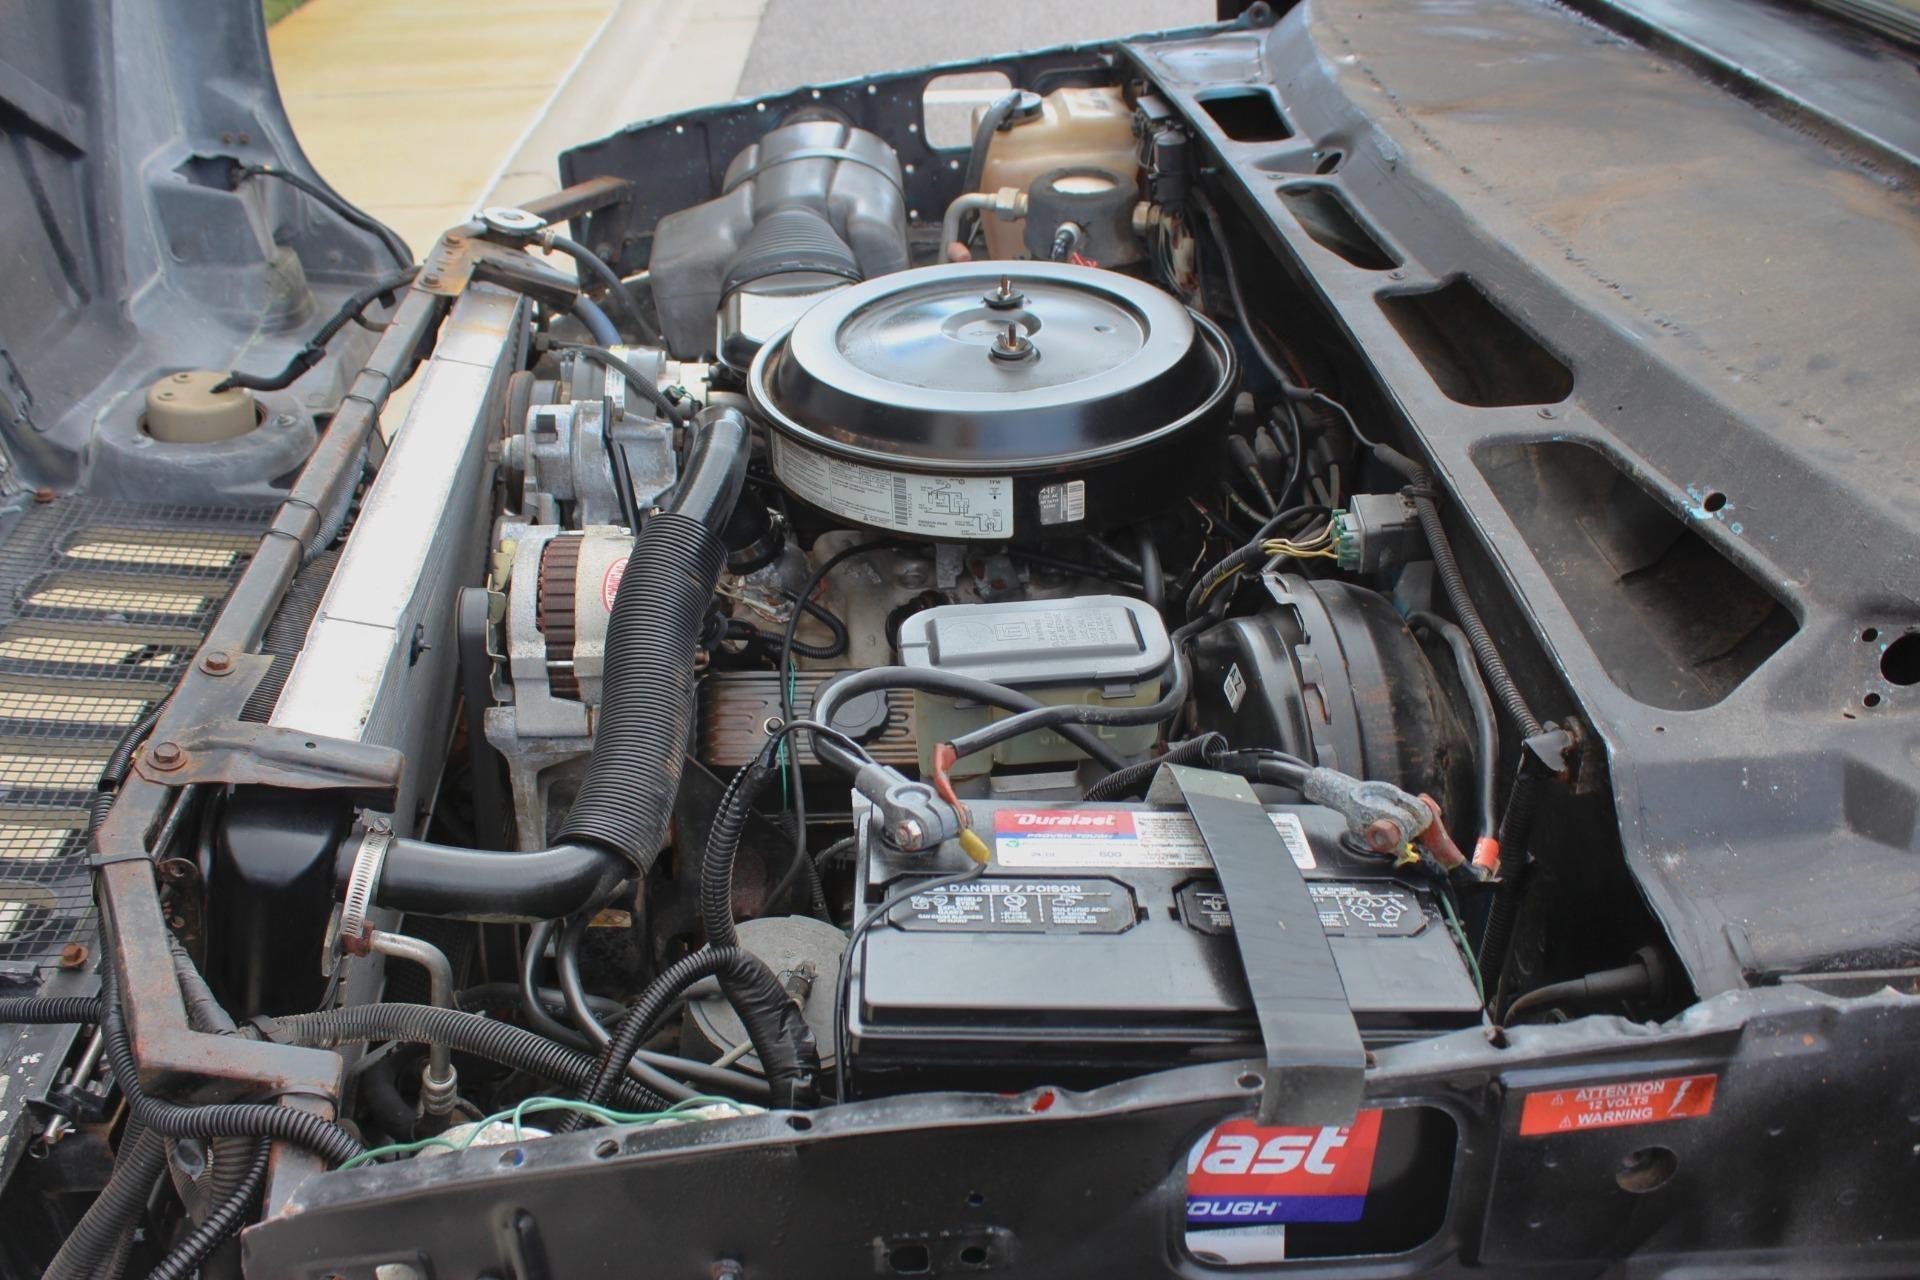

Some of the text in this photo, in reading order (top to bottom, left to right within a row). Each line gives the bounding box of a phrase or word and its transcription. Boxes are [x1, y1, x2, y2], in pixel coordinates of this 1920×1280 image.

[1014, 813, 1115, 826] Duralast
[949, 884, 1010, 893] DANGER
[1026, 884, 1082, 893] POISON
[1575, 1081, 1665, 1102] ATTENTION
[1588, 1095, 1649, 1110] 12 VOLTS
[1578, 1107, 1654, 1125] WARNING
[1187, 1201, 1277, 1216] OUGH
